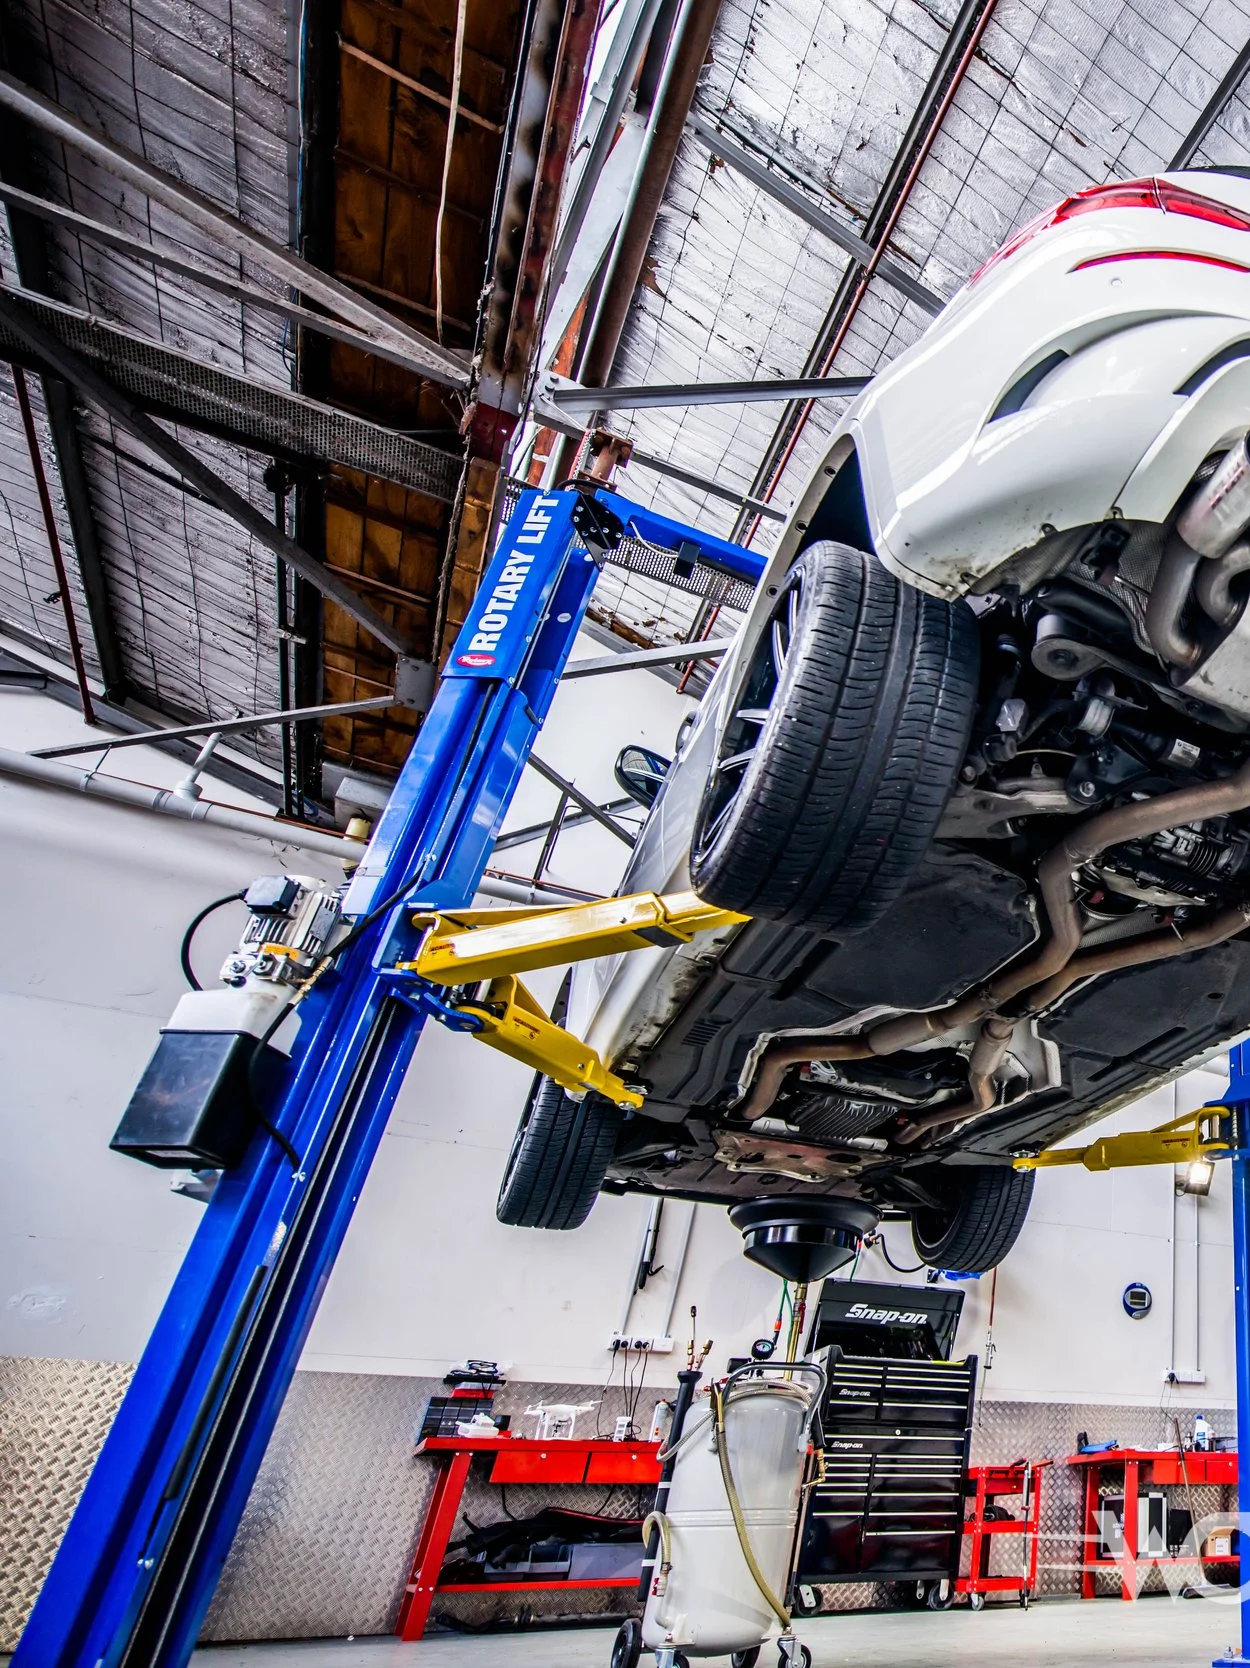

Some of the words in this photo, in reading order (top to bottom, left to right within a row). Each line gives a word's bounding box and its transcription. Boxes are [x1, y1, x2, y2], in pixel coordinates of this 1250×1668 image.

[468, 550, 536, 651] ROTARY
[516, 495, 559, 544] LIFT
[845, 1303, 928, 1325] Snap-on
[831, 1441, 864, 1450] Snap-on
